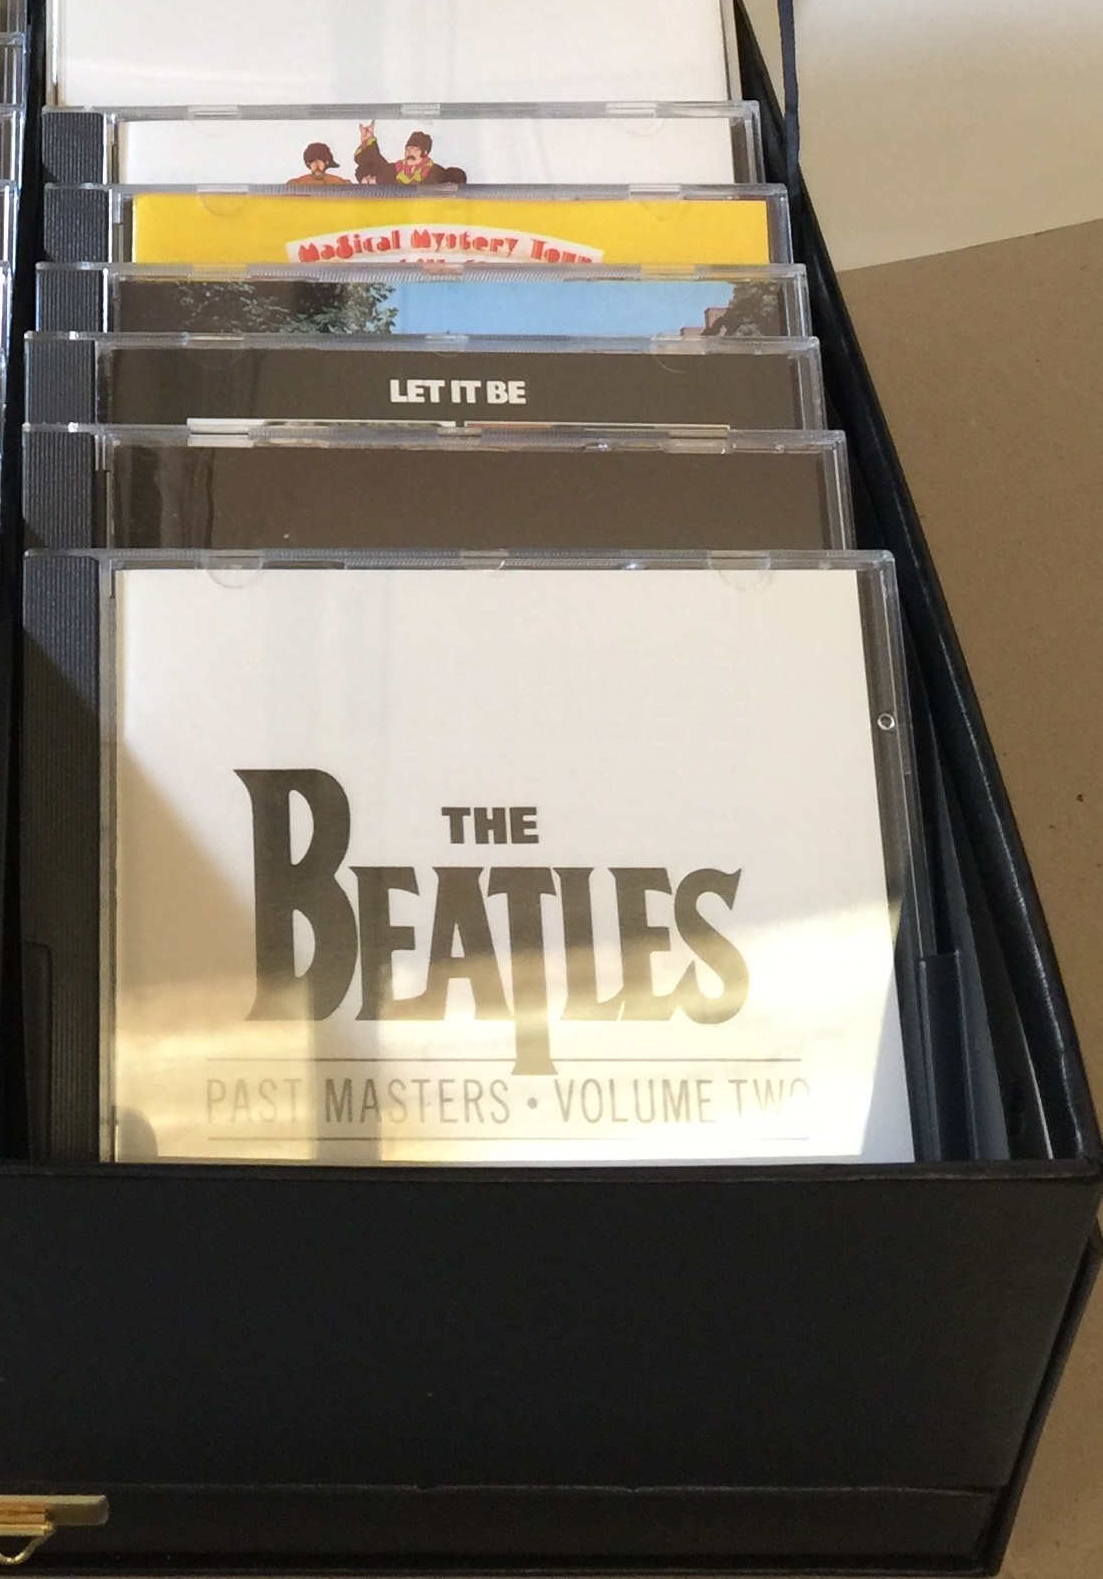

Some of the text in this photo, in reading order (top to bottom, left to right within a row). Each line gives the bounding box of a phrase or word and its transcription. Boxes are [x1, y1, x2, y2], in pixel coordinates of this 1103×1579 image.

[298, 229, 401, 263] Magical
[410, 228, 520, 257] Mystery
[389, 379, 527, 405] LET IT BE
[440, 806, 540, 845] THE
[233, 768, 751, 1076] BEATLES
[205, 1077, 303, 1123] PAST
[324, 1077, 511, 1124] MASTERS
[553, 1077, 717, 1124] VOLUME
